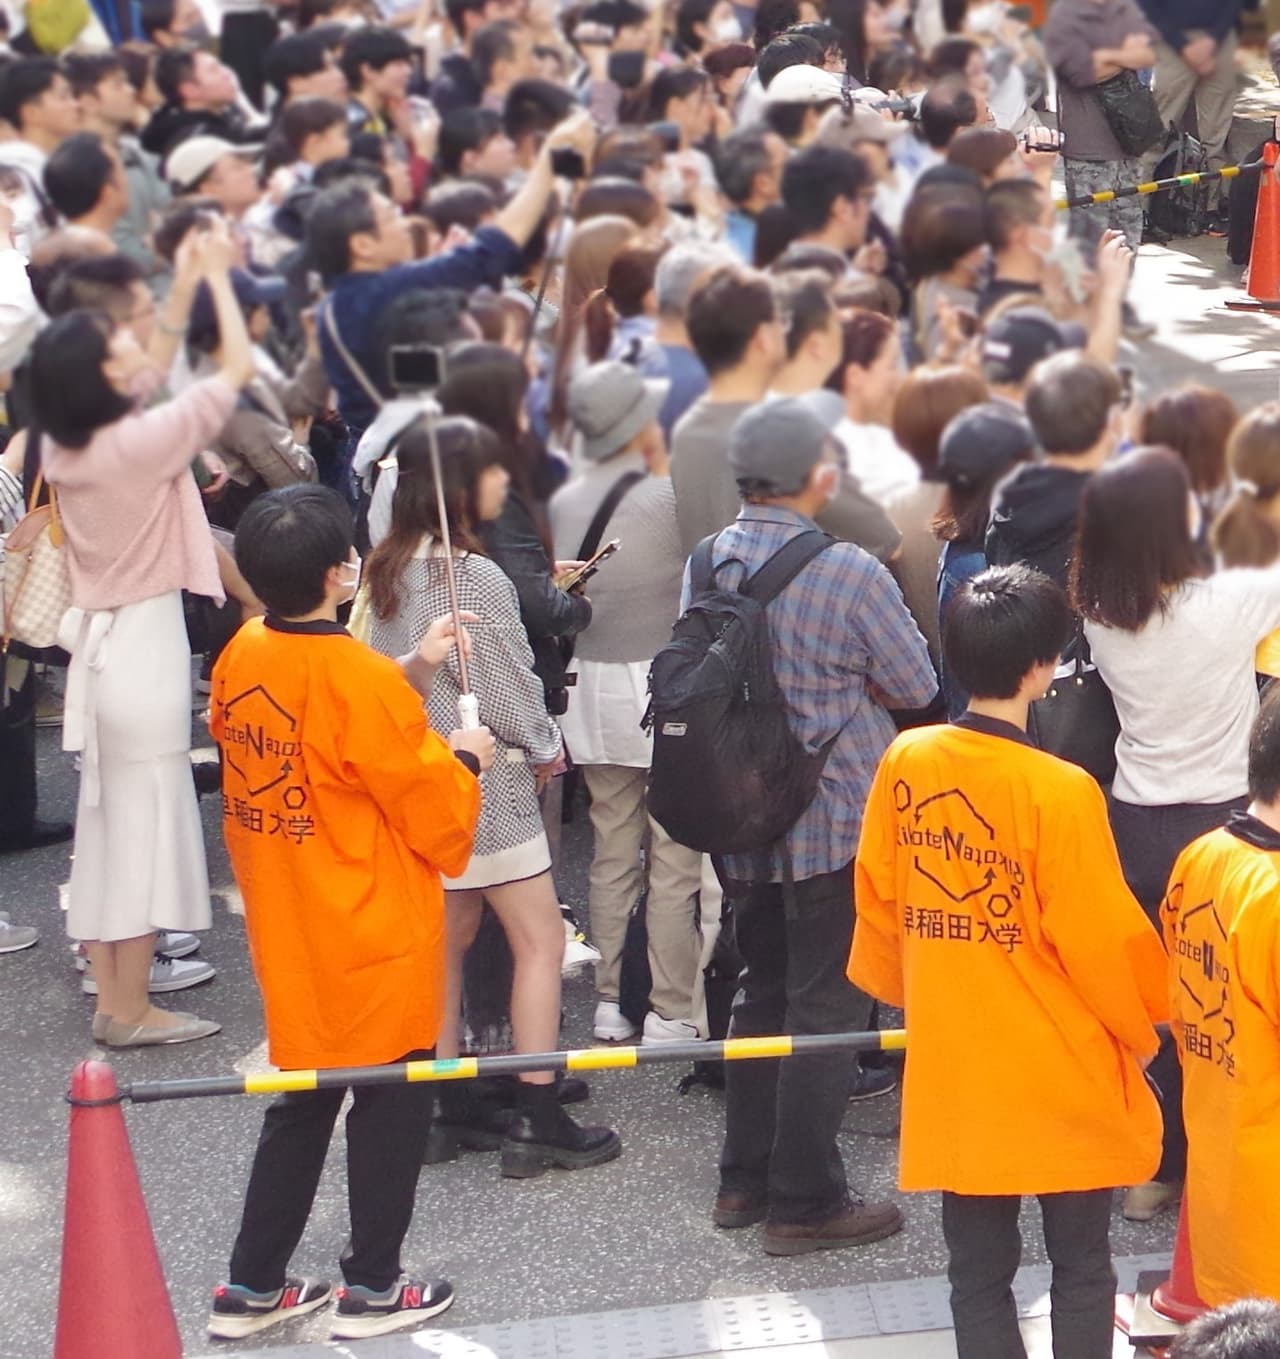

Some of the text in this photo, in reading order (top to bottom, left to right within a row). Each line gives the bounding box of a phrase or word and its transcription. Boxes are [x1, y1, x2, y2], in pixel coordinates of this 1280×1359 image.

[904, 905, 1023, 953] 早稲田大学
